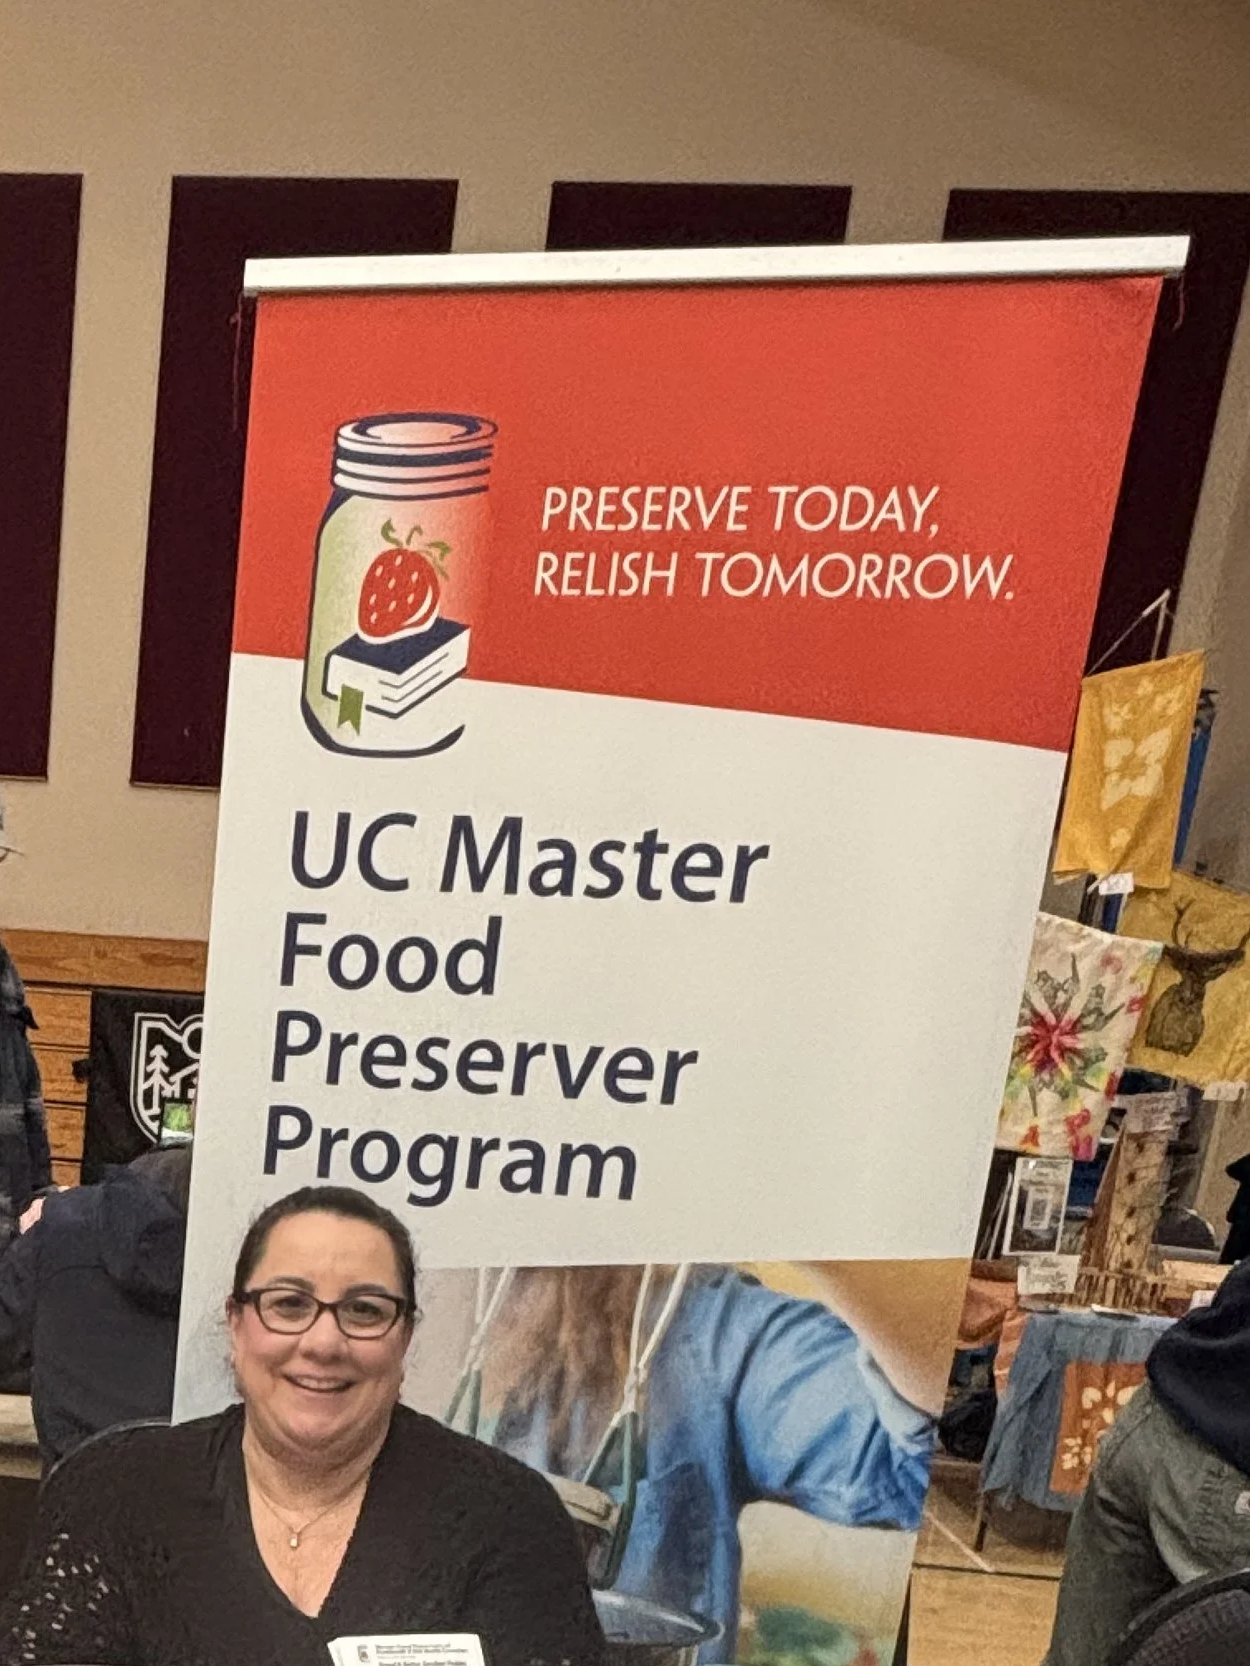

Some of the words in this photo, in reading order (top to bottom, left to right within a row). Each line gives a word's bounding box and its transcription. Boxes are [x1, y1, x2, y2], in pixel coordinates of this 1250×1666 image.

[541, 485, 752, 532] PRESERVE
[768, 485, 940, 540] TODAY,
[534, 551, 679, 597] RELISH
[695, 551, 1015, 600] TOMORROW.
[291, 810, 417, 893] UC
[440, 815, 770, 904] Master
[280, 911, 503, 996] Food
[271, 1009, 699, 1106] Preserver
[263, 1104, 638, 1208] Program
